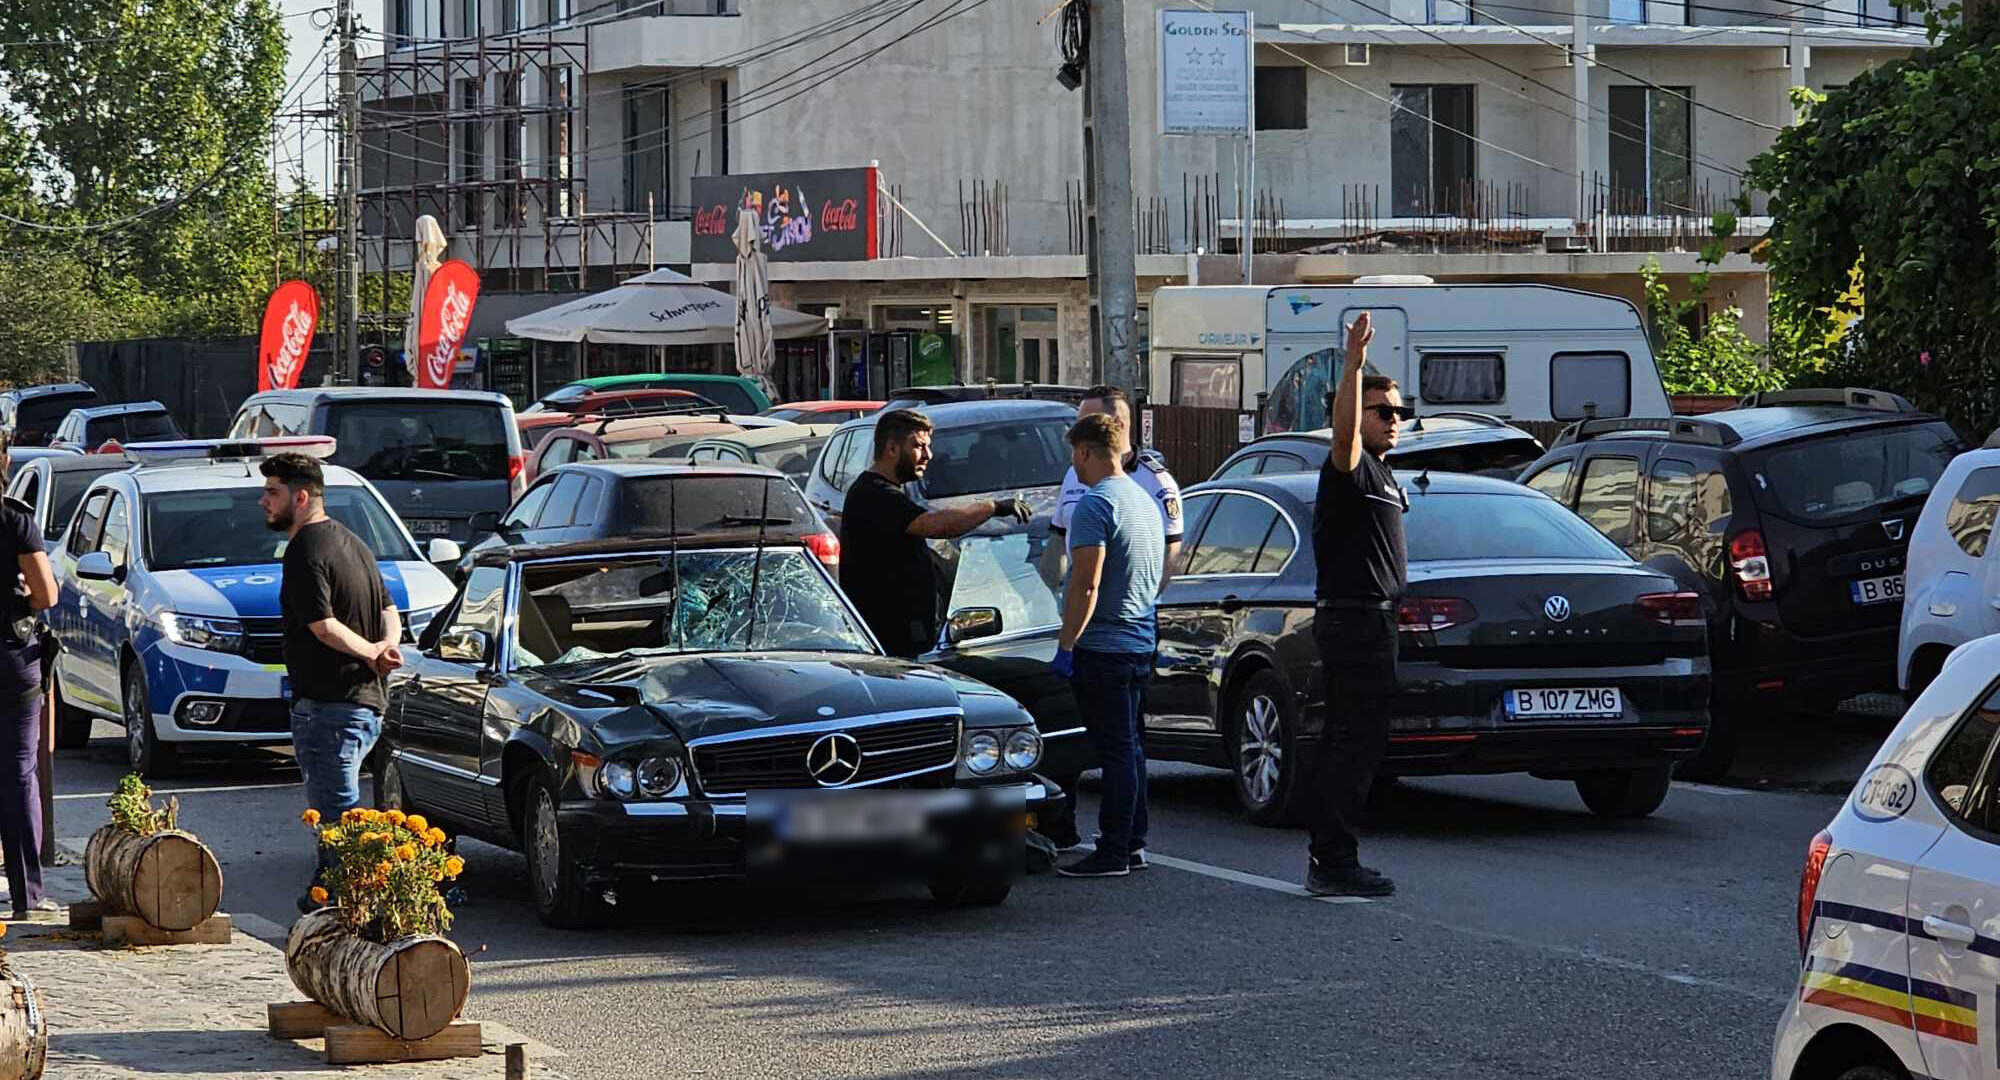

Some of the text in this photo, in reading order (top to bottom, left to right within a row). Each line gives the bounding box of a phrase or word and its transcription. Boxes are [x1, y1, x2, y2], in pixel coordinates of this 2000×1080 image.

[1164, 21, 1218, 36] GOLDEN
[649, 299, 722, 324] Schweppes
[1860, 557, 1900, 571] DUS
[1863, 581, 1878, 600] B
[1518, 689, 1615, 711] B 107 ZMG
